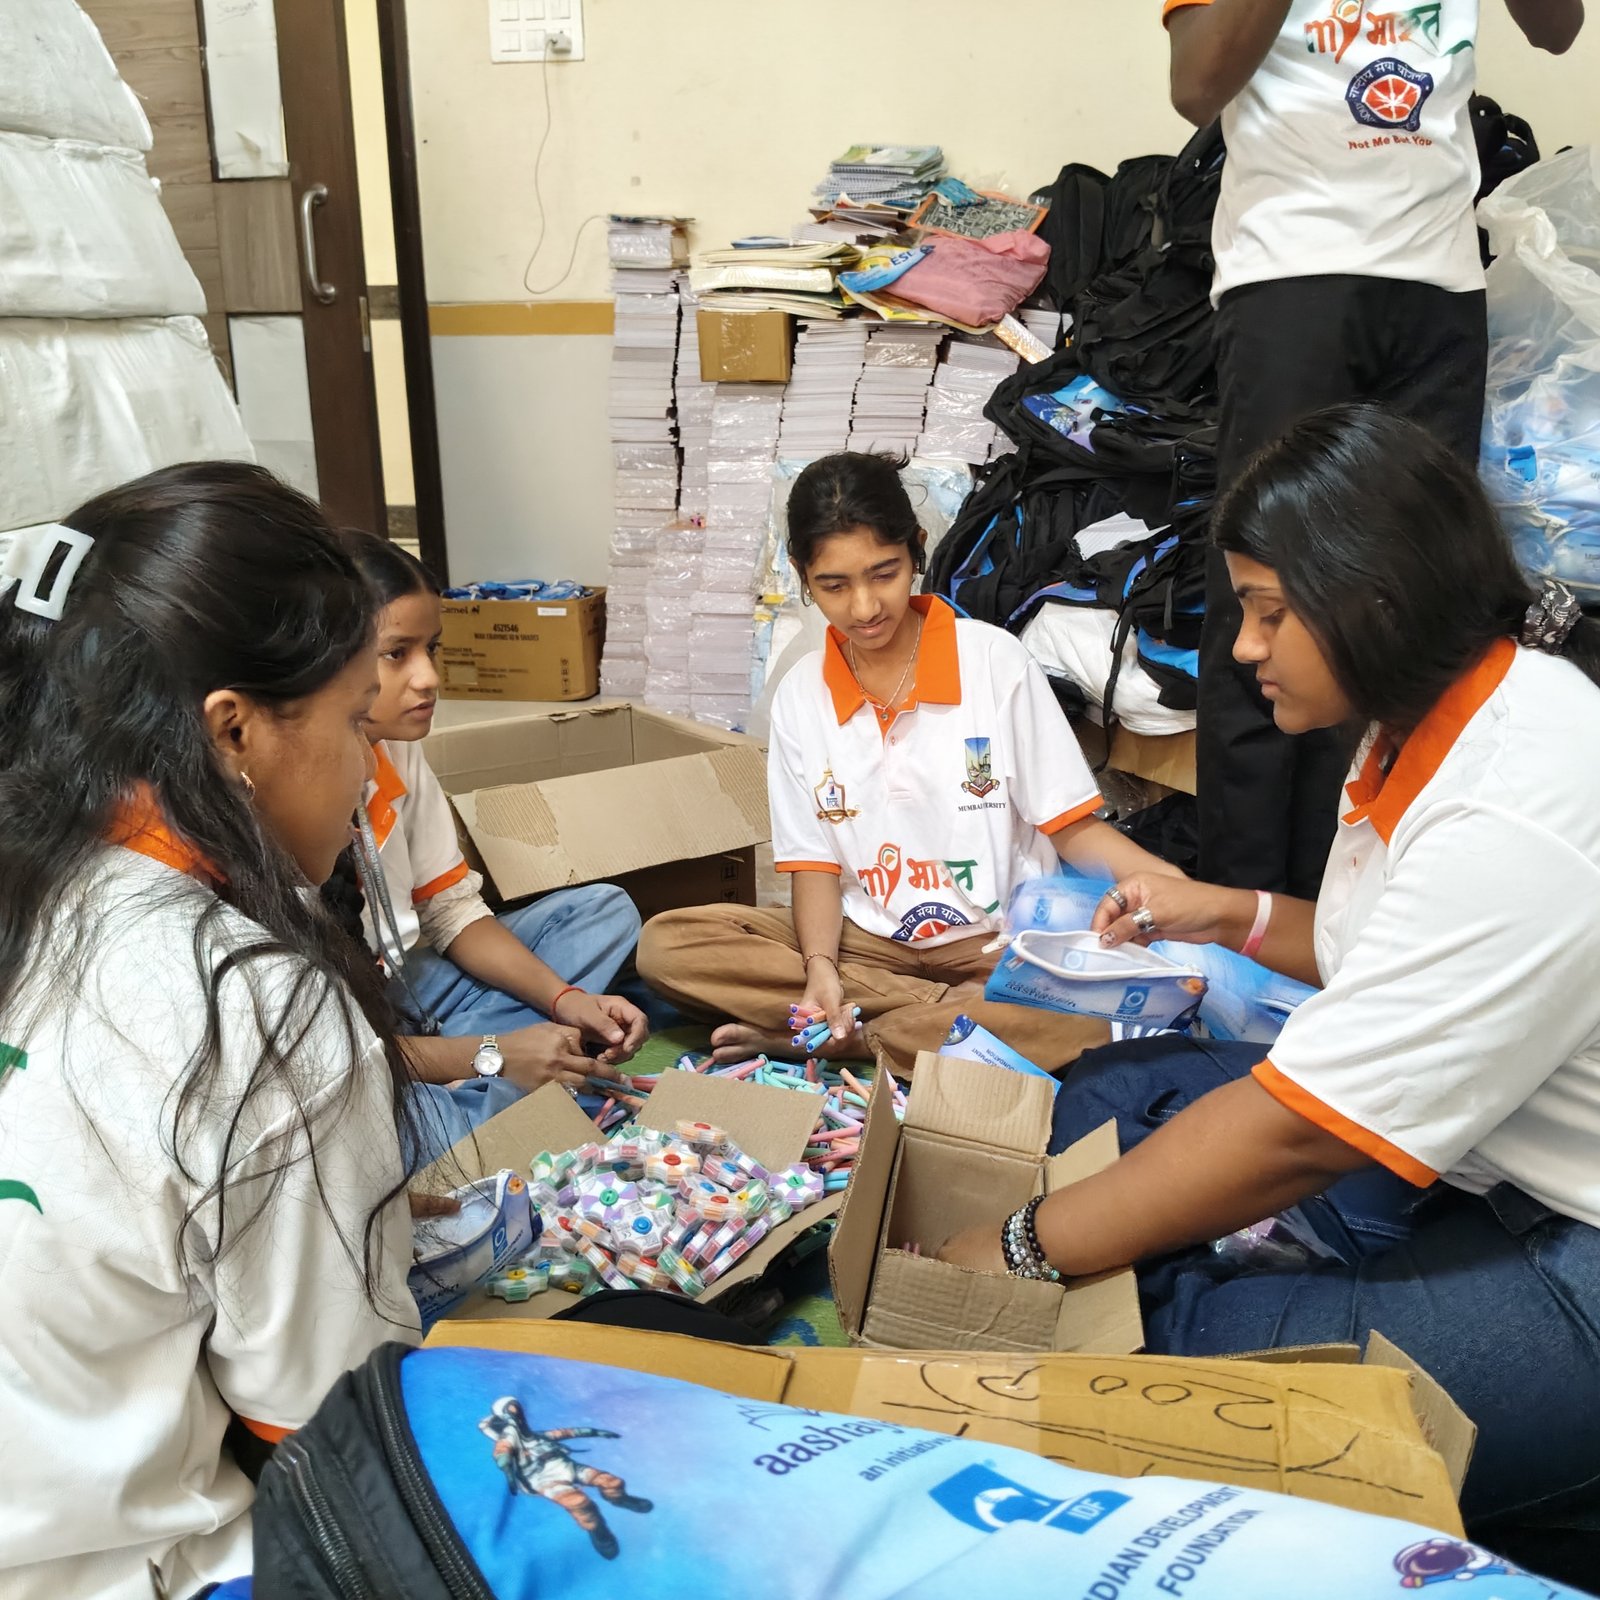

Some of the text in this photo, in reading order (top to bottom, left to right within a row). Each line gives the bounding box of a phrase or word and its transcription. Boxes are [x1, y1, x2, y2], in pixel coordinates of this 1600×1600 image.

[1348, 135, 1433, 150] Not Me But You
[986, 1049, 1016, 1072] OUNDATION
[859, 1465, 889, 1482] an
[1067, 1497, 1107, 1521] IDF
[1131, 1486, 1245, 1549] DEVELOPMENT
[1155, 1508, 1265, 1598] FOUNDATION
